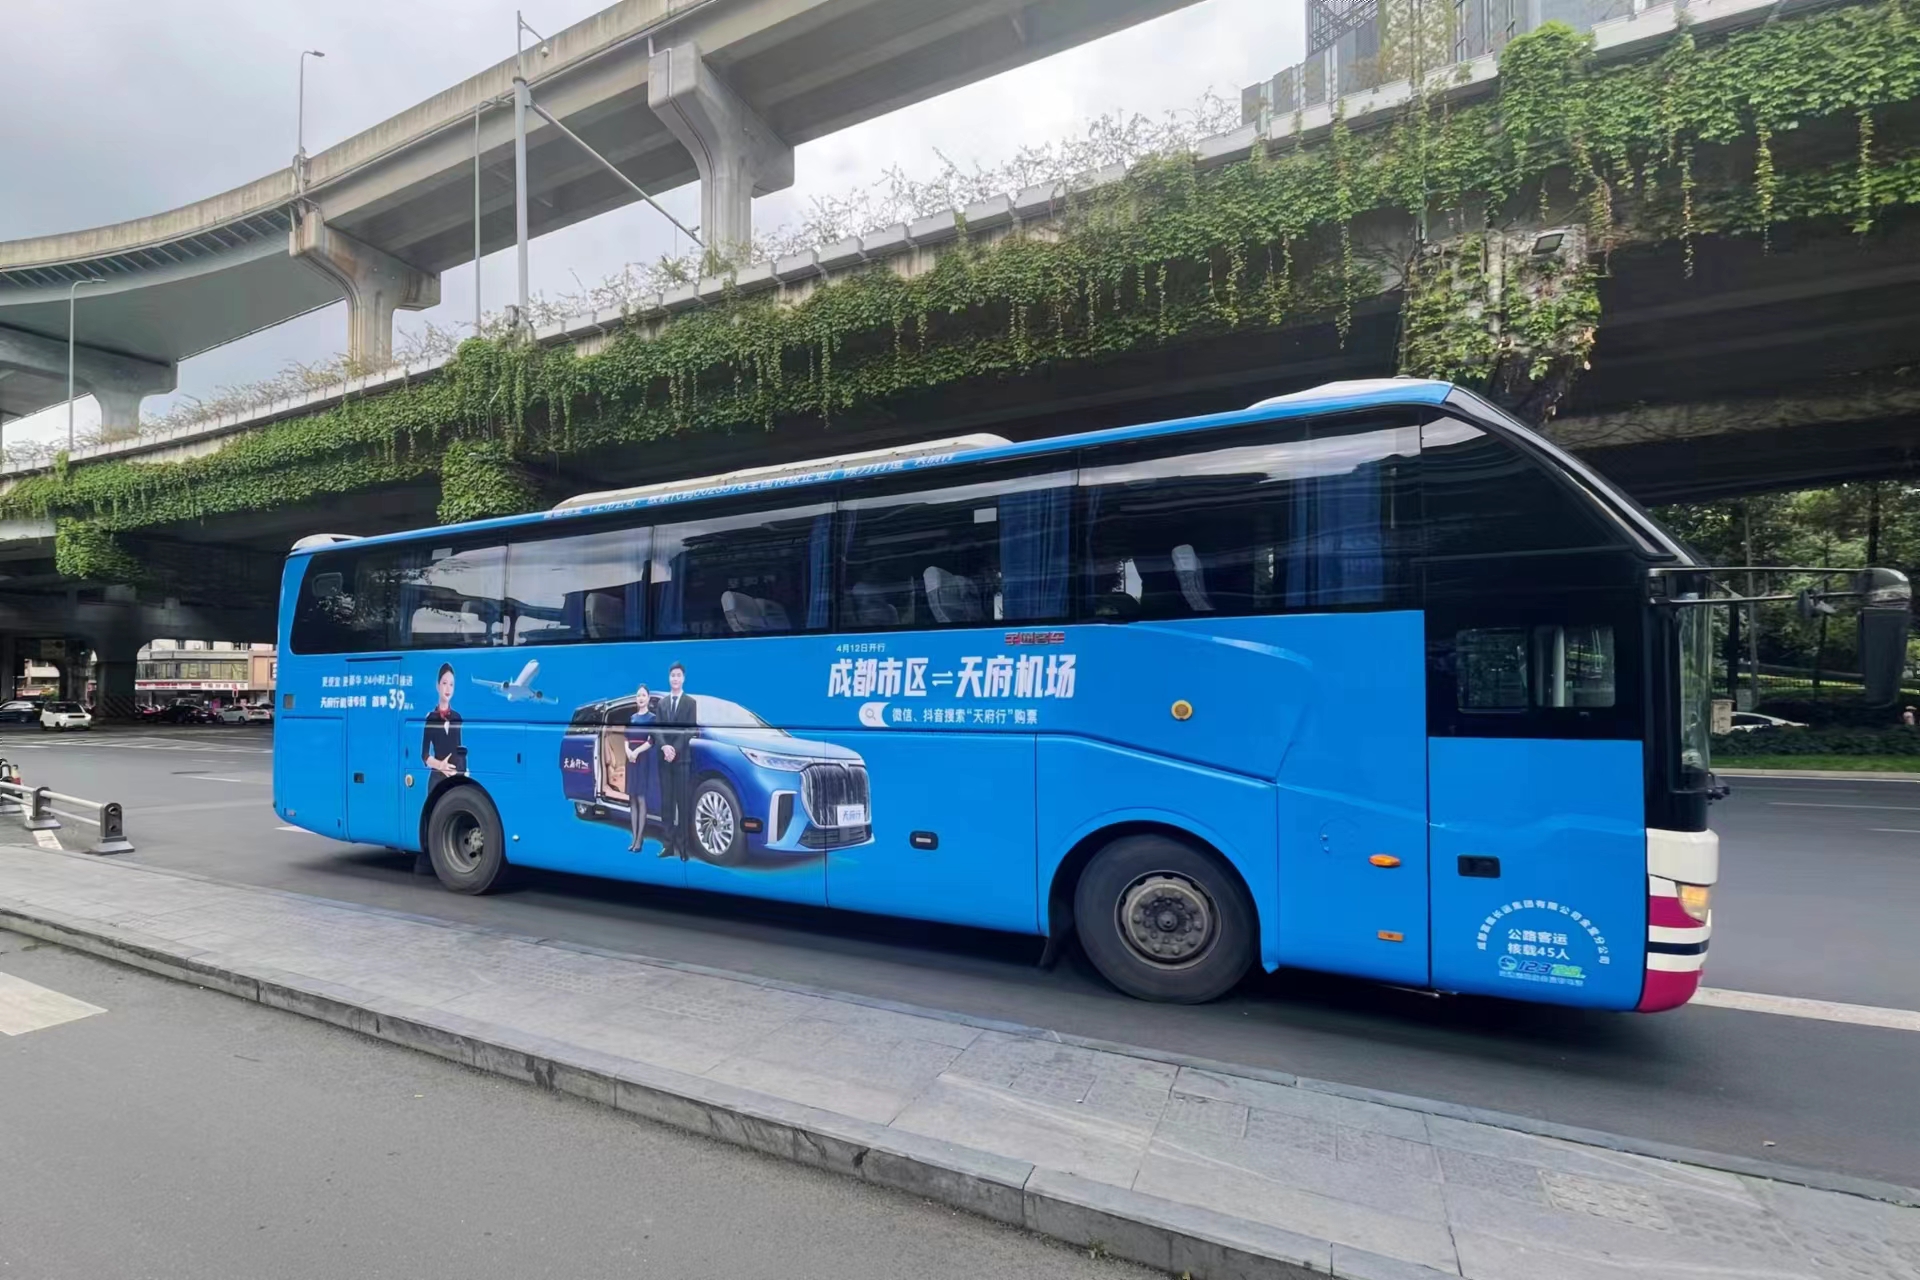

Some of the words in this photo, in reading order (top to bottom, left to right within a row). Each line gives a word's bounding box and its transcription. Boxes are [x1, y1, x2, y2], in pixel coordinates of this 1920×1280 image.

[836, 643, 886, 653] 4月12日开行
[828, 657, 929, 697] 成都市区
[955, 654, 1077, 698] 天府机场
[1507, 928, 1568, 946] 公路客运
[1507, 942, 1571, 961] 核载45人
